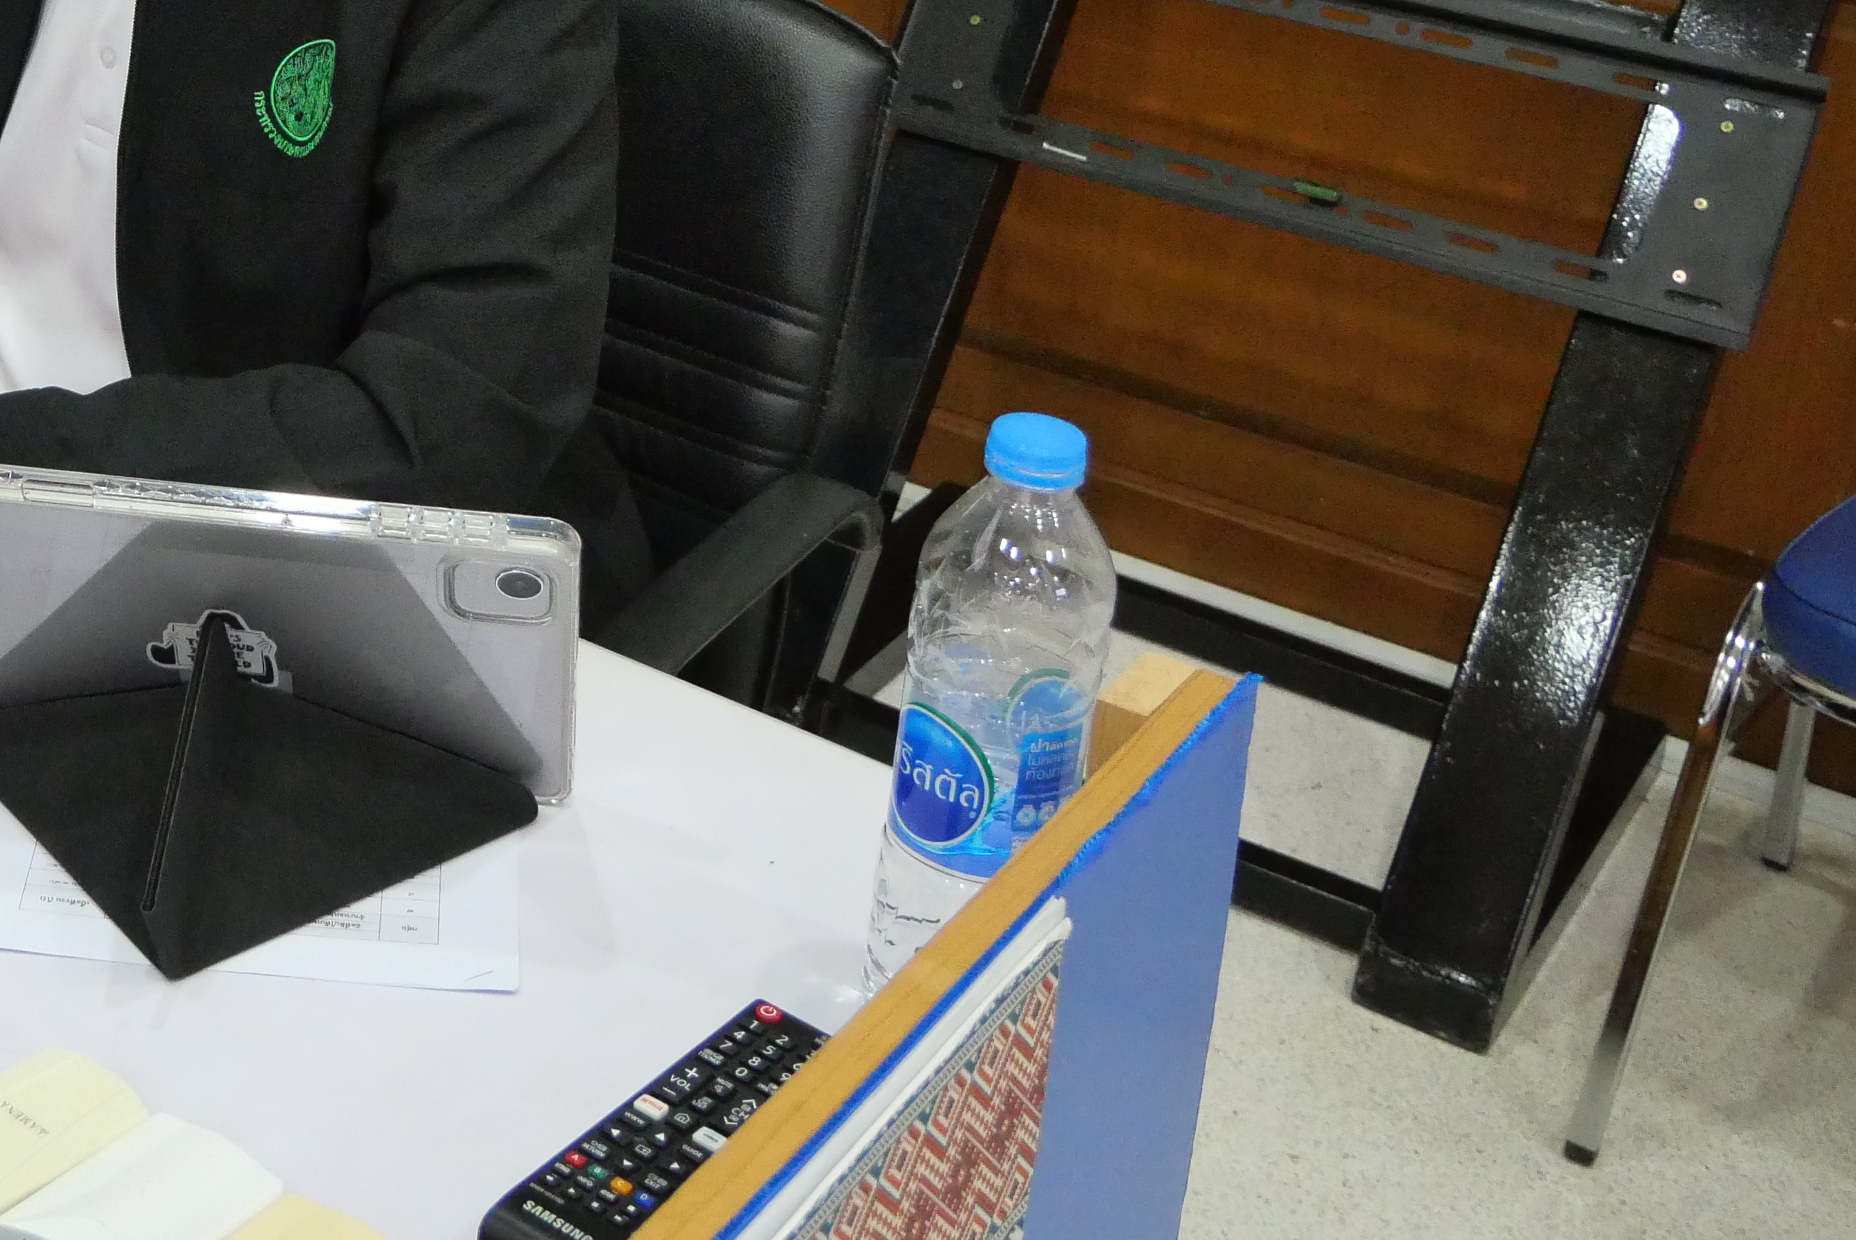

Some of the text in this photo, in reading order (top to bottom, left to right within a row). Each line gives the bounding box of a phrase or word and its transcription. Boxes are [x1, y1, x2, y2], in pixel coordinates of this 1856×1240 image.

[899, 741, 980, 818] ริสตัล
[749, 1020, 759, 1030] 1
[733, 1031, 746, 1040] 4
[775, 1034, 789, 1046] 2
[719, 1040, 733, 1050] 7
[762, 1045, 776, 1055] 5
[748, 1056, 761, 1066] 8
[735, 1067, 748, 1077] 0
[670, 1074, 692, 1091] VOL
[581, 1142, 607, 1159] RETURN
[682, 1144, 703, 1158] GUIDE
[577, 1175, 594, 1187] INFO
[644, 1178, 661, 1189] EXIT
